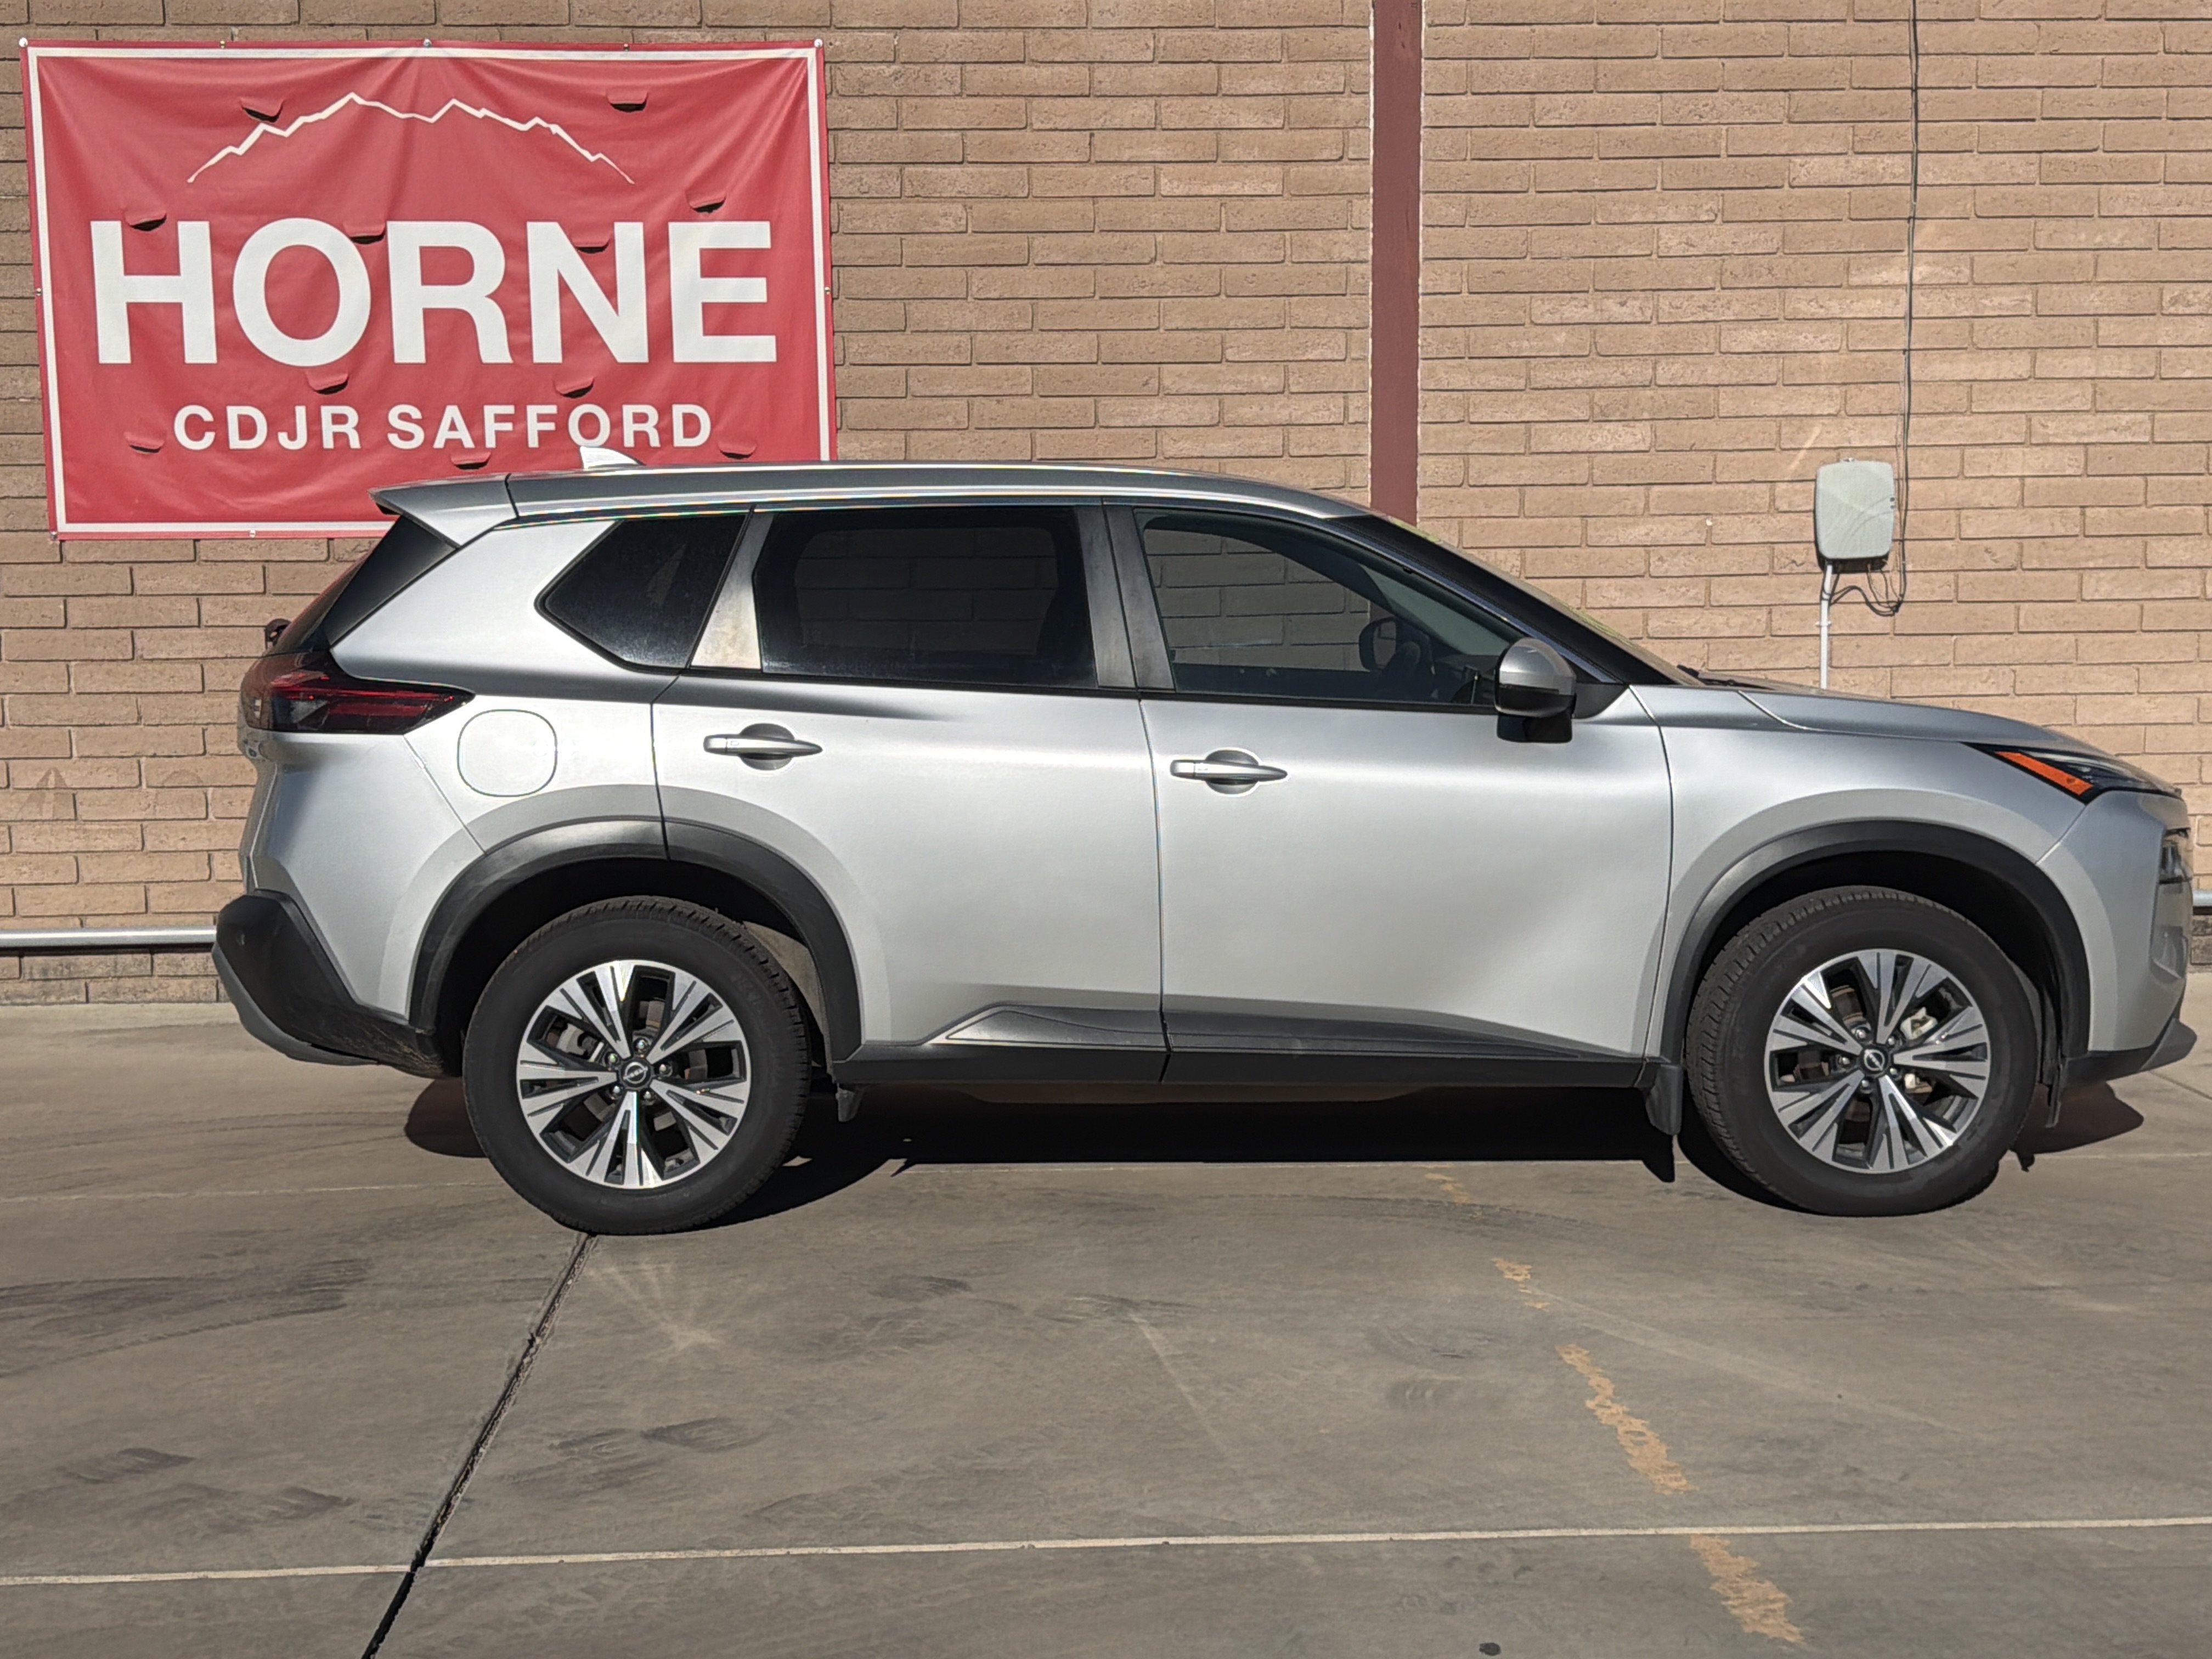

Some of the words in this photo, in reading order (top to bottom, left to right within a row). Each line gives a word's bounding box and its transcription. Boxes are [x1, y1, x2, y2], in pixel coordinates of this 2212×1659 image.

[90, 218, 777, 366] HORNE
[173, 404, 361, 450] CDJR
[387, 404, 711, 450] SAFFORD
